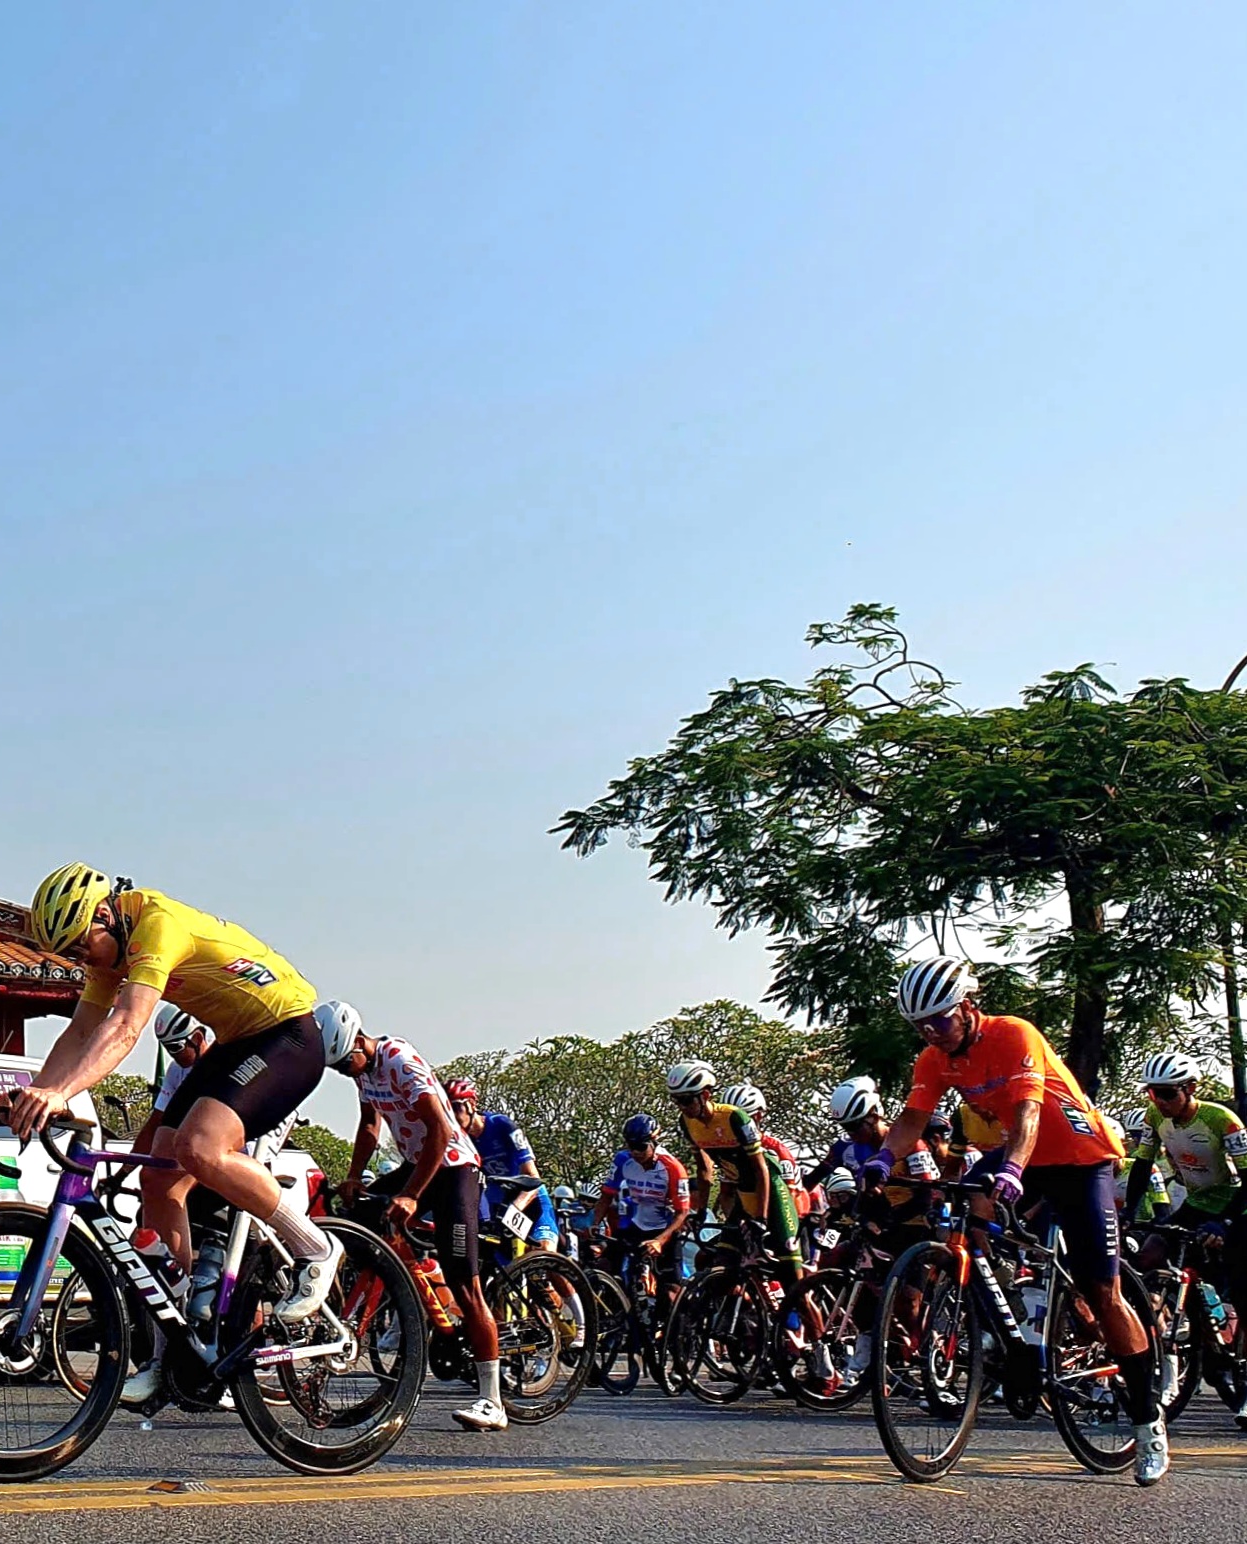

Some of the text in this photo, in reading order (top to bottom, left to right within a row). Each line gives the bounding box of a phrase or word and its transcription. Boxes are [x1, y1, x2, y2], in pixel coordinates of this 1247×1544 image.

[224, 959, 275, 986] HTV
[511, 1212, 525, 1230] 61
[92, 1217, 187, 1326] GIANT
[255, 1352, 291, 1366] SHIMANO
